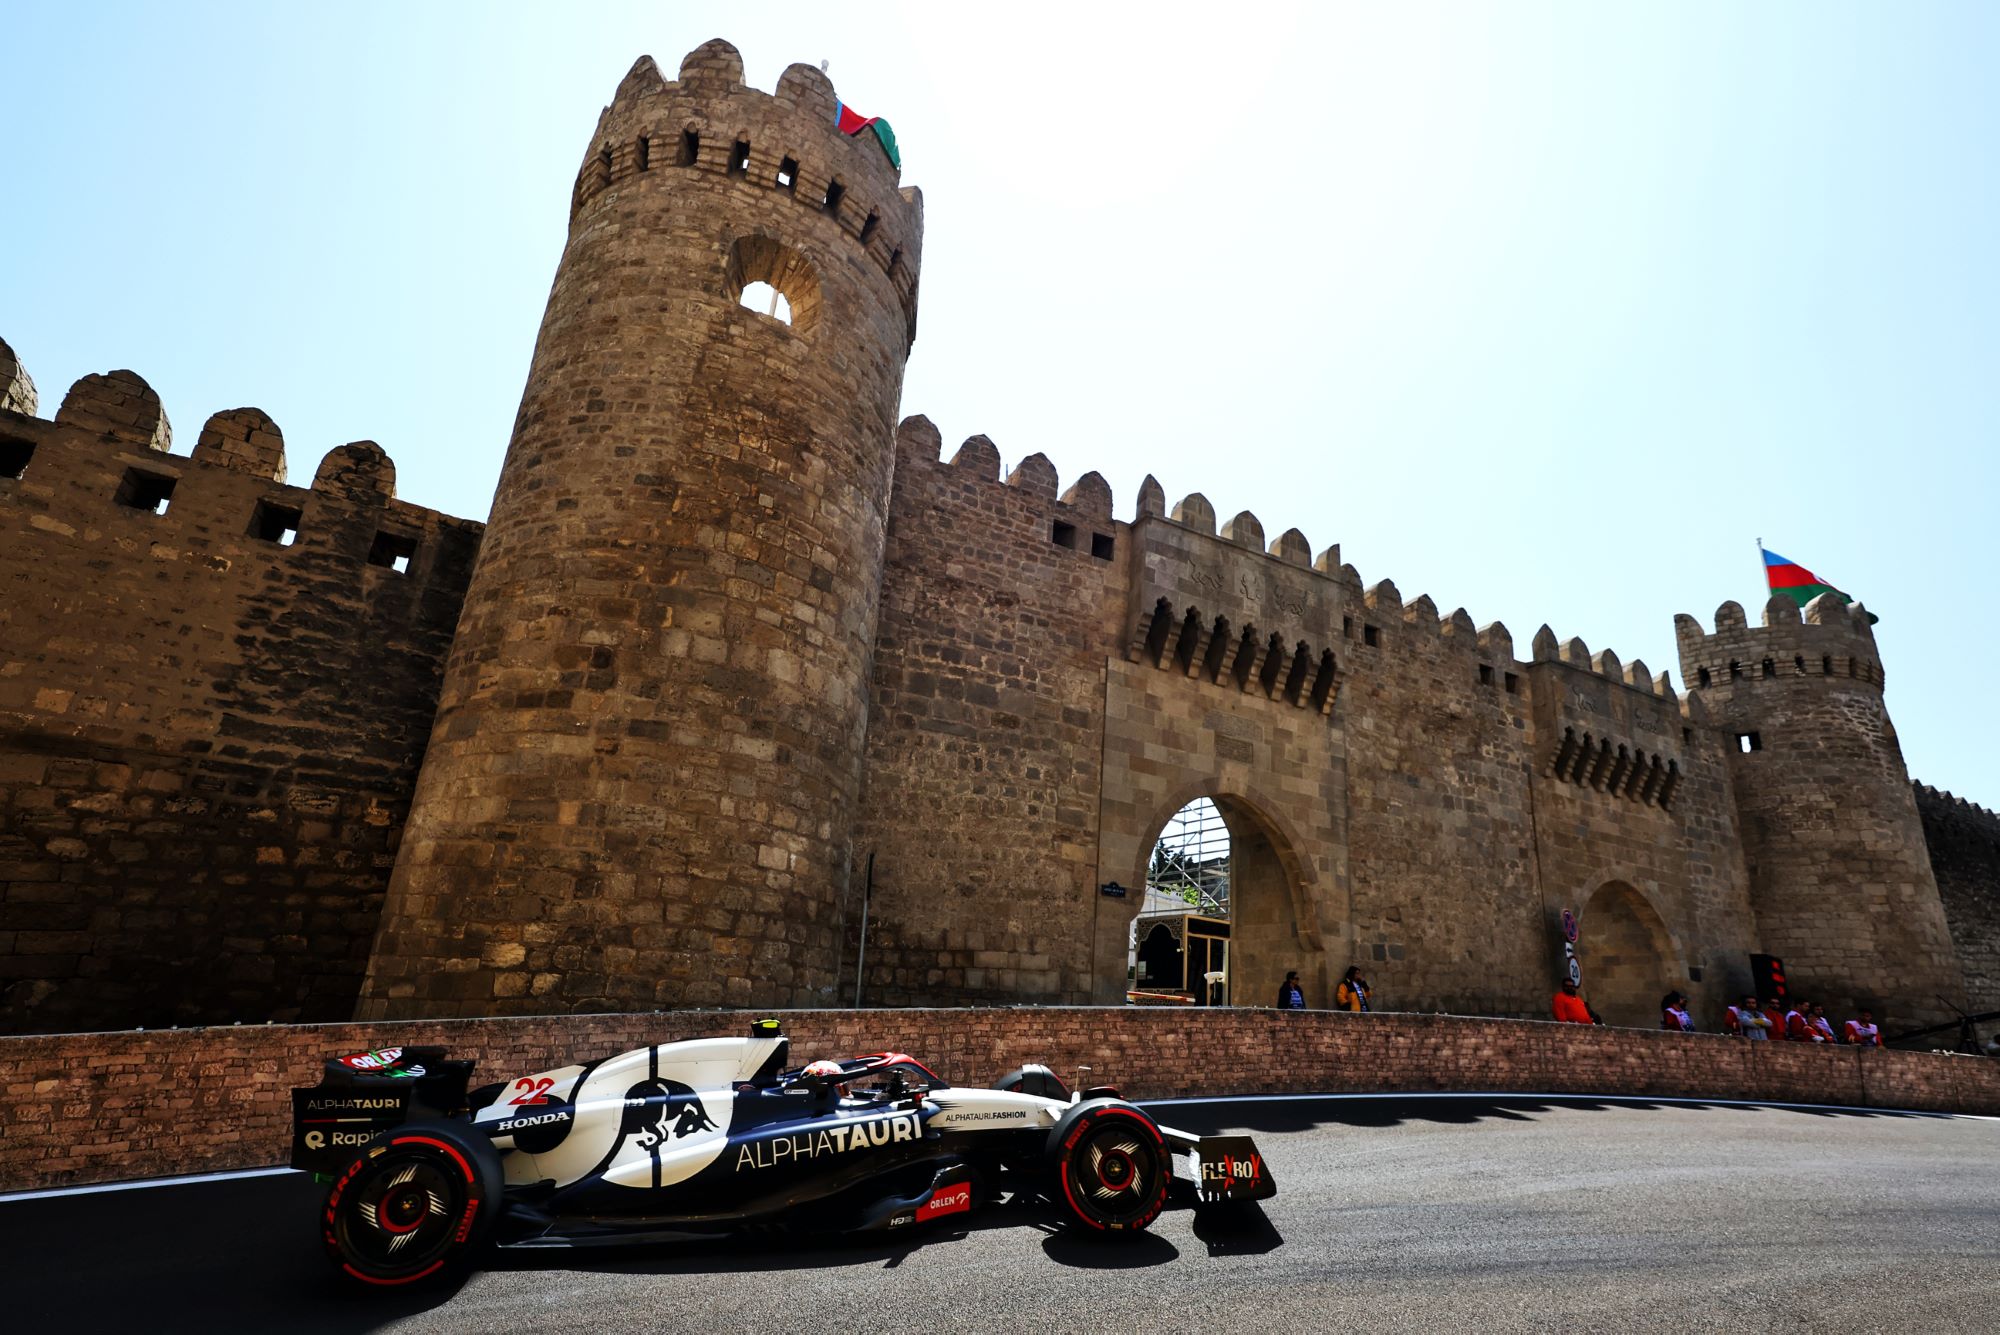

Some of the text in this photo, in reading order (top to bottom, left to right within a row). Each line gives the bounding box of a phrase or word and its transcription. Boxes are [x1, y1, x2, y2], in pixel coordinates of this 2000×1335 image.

[351, 1049, 402, 1069] ORLEN
[508, 1077, 555, 1106] 22
[307, 1099, 400, 1110] ALPHATAURI
[498, 1111, 570, 1131] HONDA
[945, 1111, 1026, 1122] ALPHATAURI.FASHION
[735, 1113, 922, 1172] ALPHATAURI
[930, 1196, 955, 1209] ORLEN
